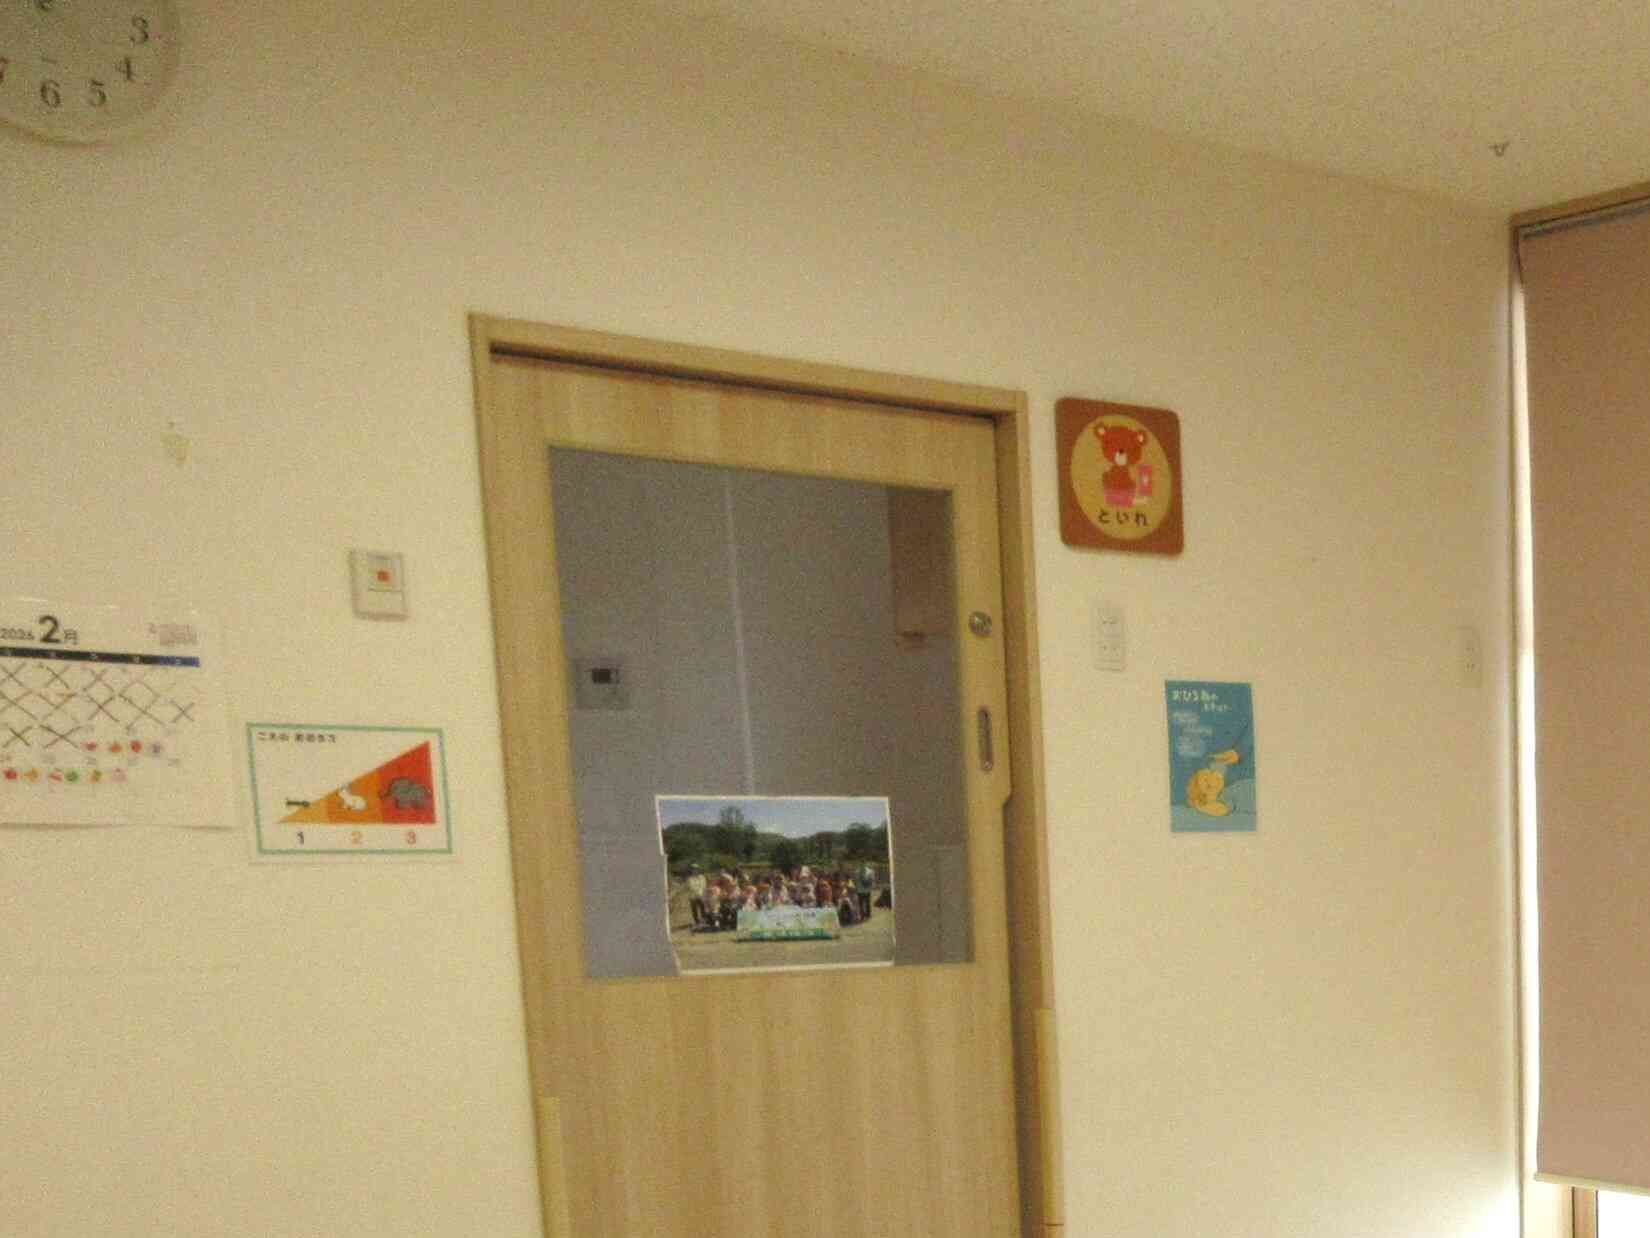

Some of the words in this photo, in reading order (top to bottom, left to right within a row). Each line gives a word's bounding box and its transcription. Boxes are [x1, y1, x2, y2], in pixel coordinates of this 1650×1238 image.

[129, 15, 149, 43] 3
[115, 56, 135, 82] 4
[40, 79, 62, 108] 6
[89, 79, 107, 107] 5
[1098, 508, 1148, 526] といれ
[297, 831, 305, 845] 1
[351, 831, 363, 845] 2
[406, 831, 417, 845] 3
